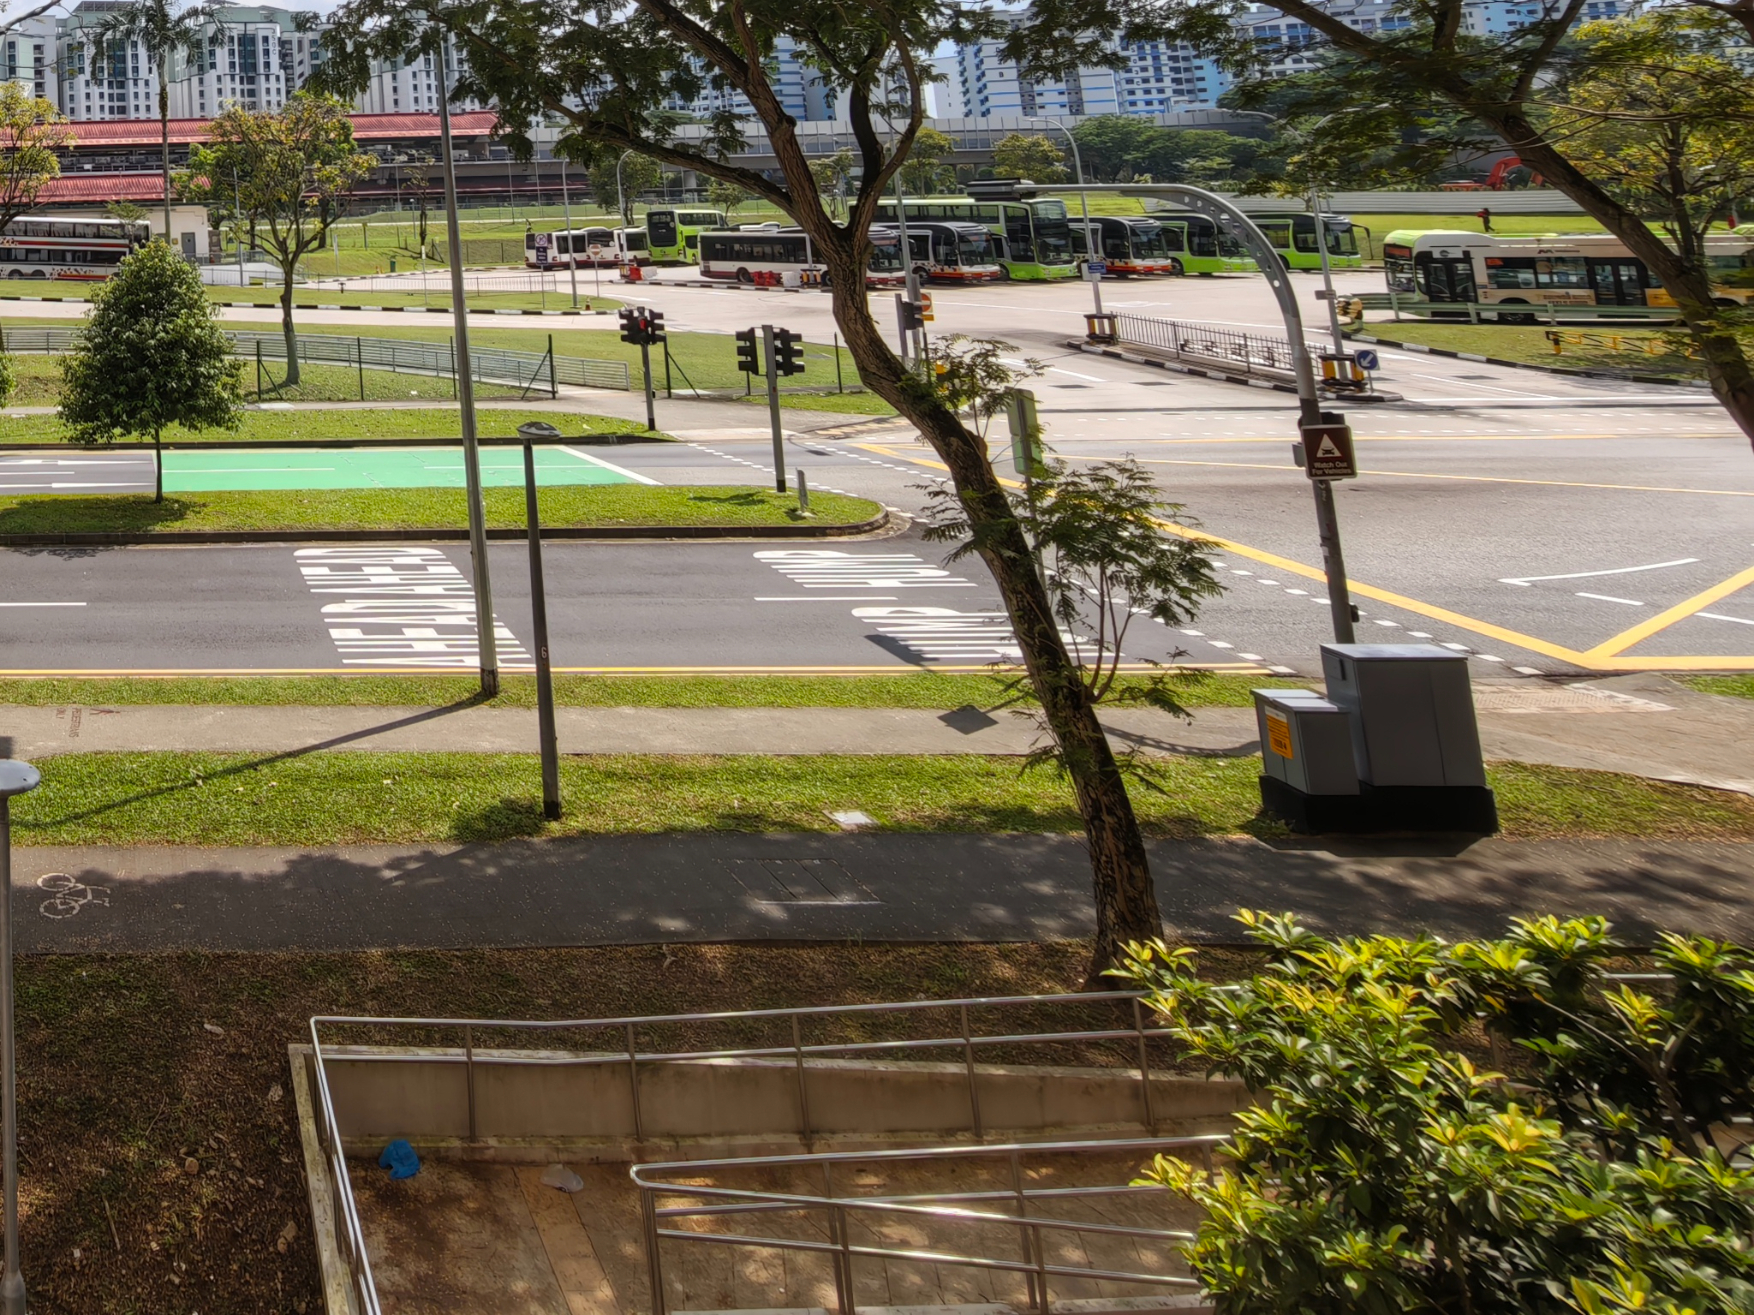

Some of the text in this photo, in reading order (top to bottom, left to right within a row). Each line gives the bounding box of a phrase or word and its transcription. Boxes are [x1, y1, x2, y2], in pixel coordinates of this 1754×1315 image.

[1313, 461, 1334, 469] Watch
[293, 547, 476, 595] AHEAD
[753, 550, 979, 588] HUMP
[320, 602, 537, 668] AHEAD
[541, 646, 547, 659] 6
